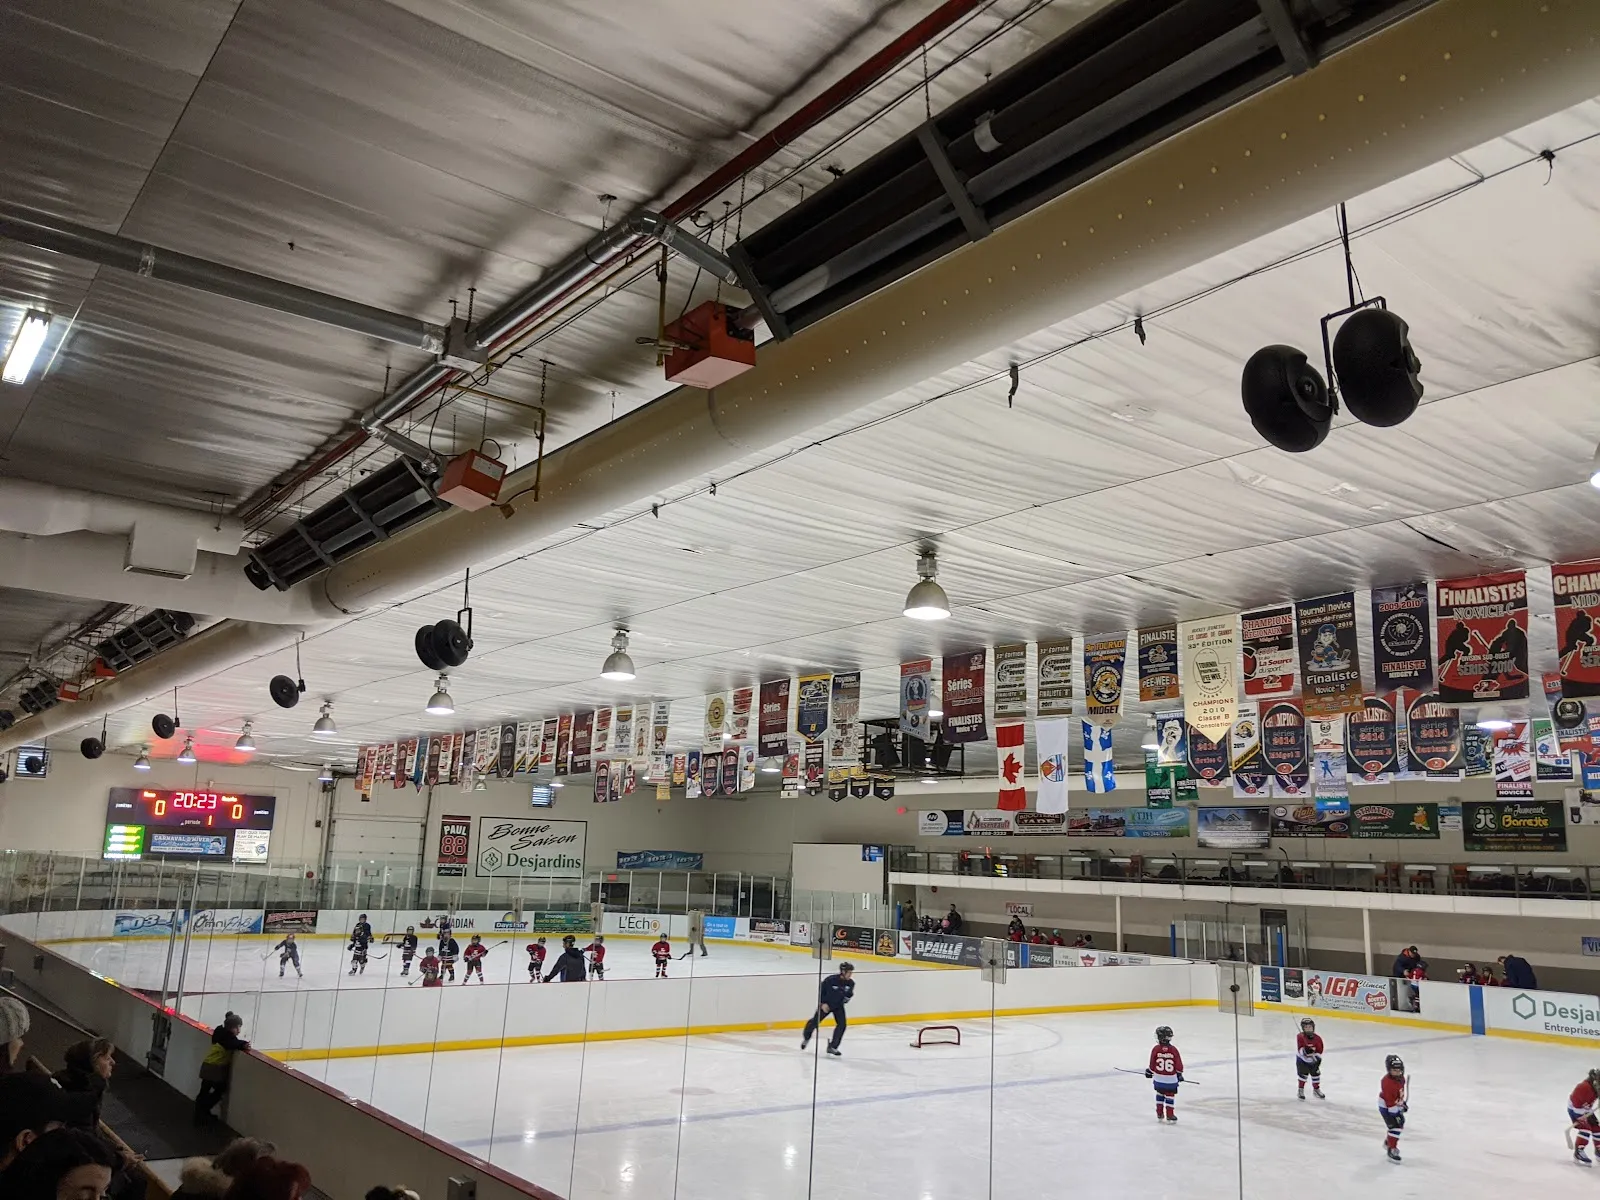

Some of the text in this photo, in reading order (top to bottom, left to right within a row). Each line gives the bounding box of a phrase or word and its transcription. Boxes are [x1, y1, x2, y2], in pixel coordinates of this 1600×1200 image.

[1439, 581, 1525, 607] FINALISTES
[1300, 604, 1326, 616] Tournoi
[1452, 606, 1502, 620] NOVICE
[1242, 614, 1292, 630] CHAMPIONS
[1140, 630, 1176, 646] FINALISTE
[1202, 638, 1232, 647] ÉDITION
[1382, 660, 1426, 672] FINALISTE
[947, 678, 972, 692] Séries
[1306, 671, 1358, 685] Finaliste
[1315, 686, 1336, 695] Novice
[1088, 705, 1119, 714] MIDGET
[1193, 698, 1234, 707] CHAMPIONS
[948, 714, 983, 727] FINALISTES
[1198, 714, 1222, 722] Classe
[155, 800, 166, 815] 0
[174, 792, 217, 809] 20:23
[232, 804, 242, 819] 0
[208, 815, 212, 825] 1
[1502, 815, 1549, 828] Barrette
[444, 825, 466, 836] PAUL
[488, 824, 551, 840] Bonne
[441, 836, 466, 855] 88
[511, 834, 577, 850] Saison
[506, 853, 581, 872] Desjardins
[1010, 906, 1030, 914] LOCAL
[435, 918, 475, 928] CADIAN
[1324, 977, 1358, 997] IGA
[1545, 1022, 1600, 1036] Entreprises
[1156, 1058, 1174, 1072] 36
